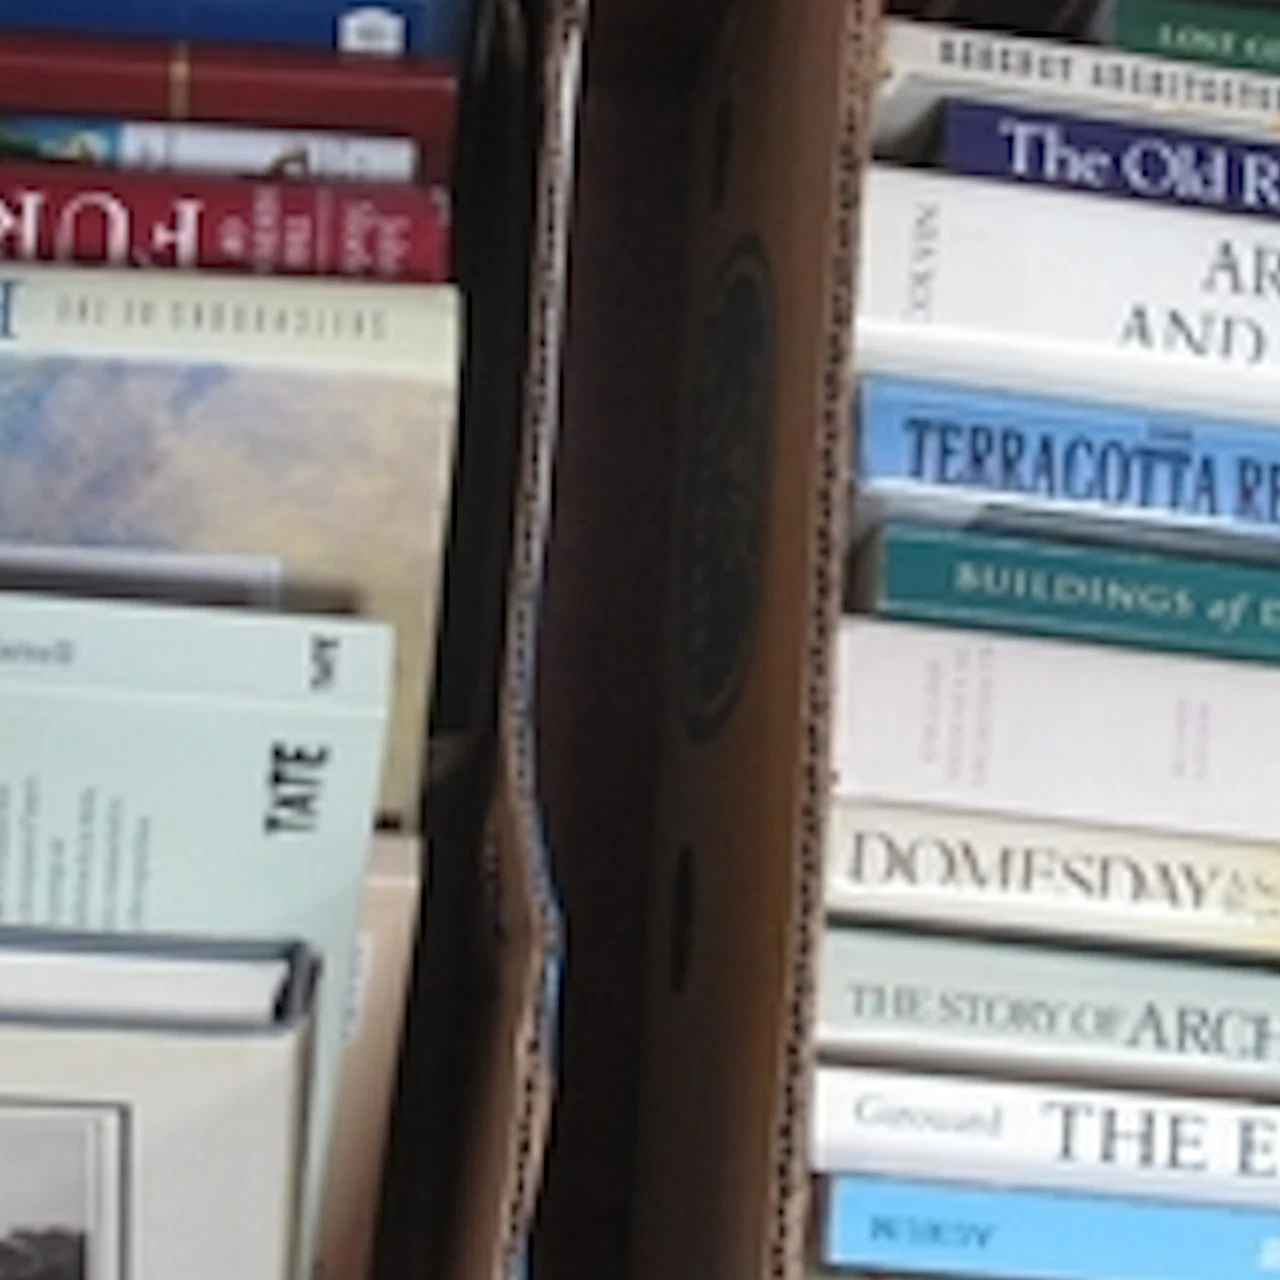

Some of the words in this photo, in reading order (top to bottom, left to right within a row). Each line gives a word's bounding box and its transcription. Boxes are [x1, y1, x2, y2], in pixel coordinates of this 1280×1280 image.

[1159, 23, 1238, 53] LOST
[998, 120, 1112, 189] The
[1123, 138, 1229, 200] Old
[1121, 304, 1267, 367] AND
[904, 417, 1217, 520] TERRACOTTA
[953, 560, 1196, 617] BUILDINGS
[1207, 593, 1256, 632] of
[263, 740, 331, 836] TATE
[846, 830, 1228, 912] DOMESDAY
[848, 984, 923, 1021] THE
[937, 993, 1061, 1033] STORY
[1070, 1003, 1121, 1040] OF
[1040, 1100, 1211, 1173] THE
